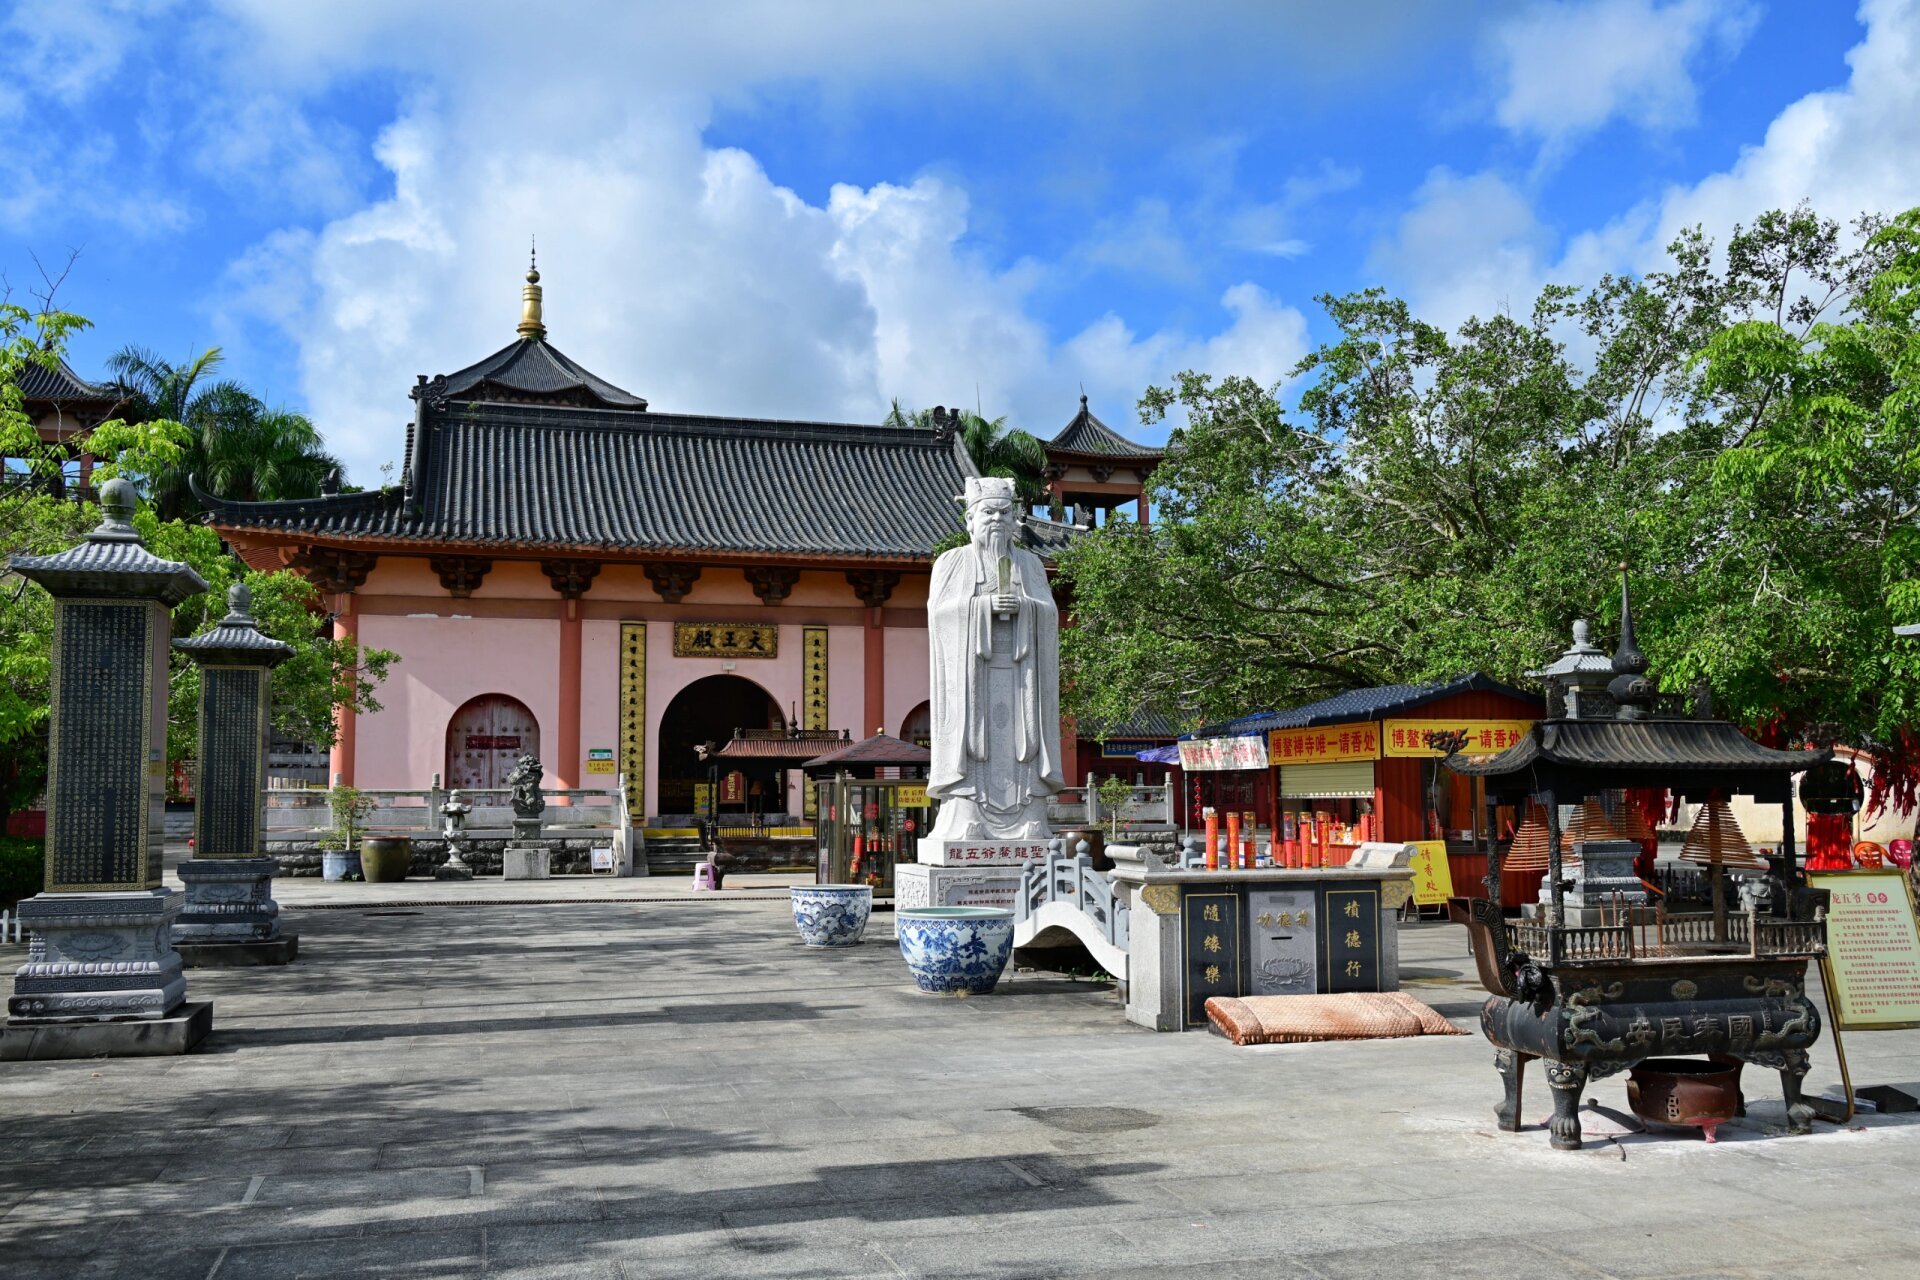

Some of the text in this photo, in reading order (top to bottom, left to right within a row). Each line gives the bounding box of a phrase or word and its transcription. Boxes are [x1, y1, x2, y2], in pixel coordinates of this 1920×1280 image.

[1272, 730, 1376, 758] 博鳌禅寺唯一请香处
[1420, 847, 1439, 891] 请香处
